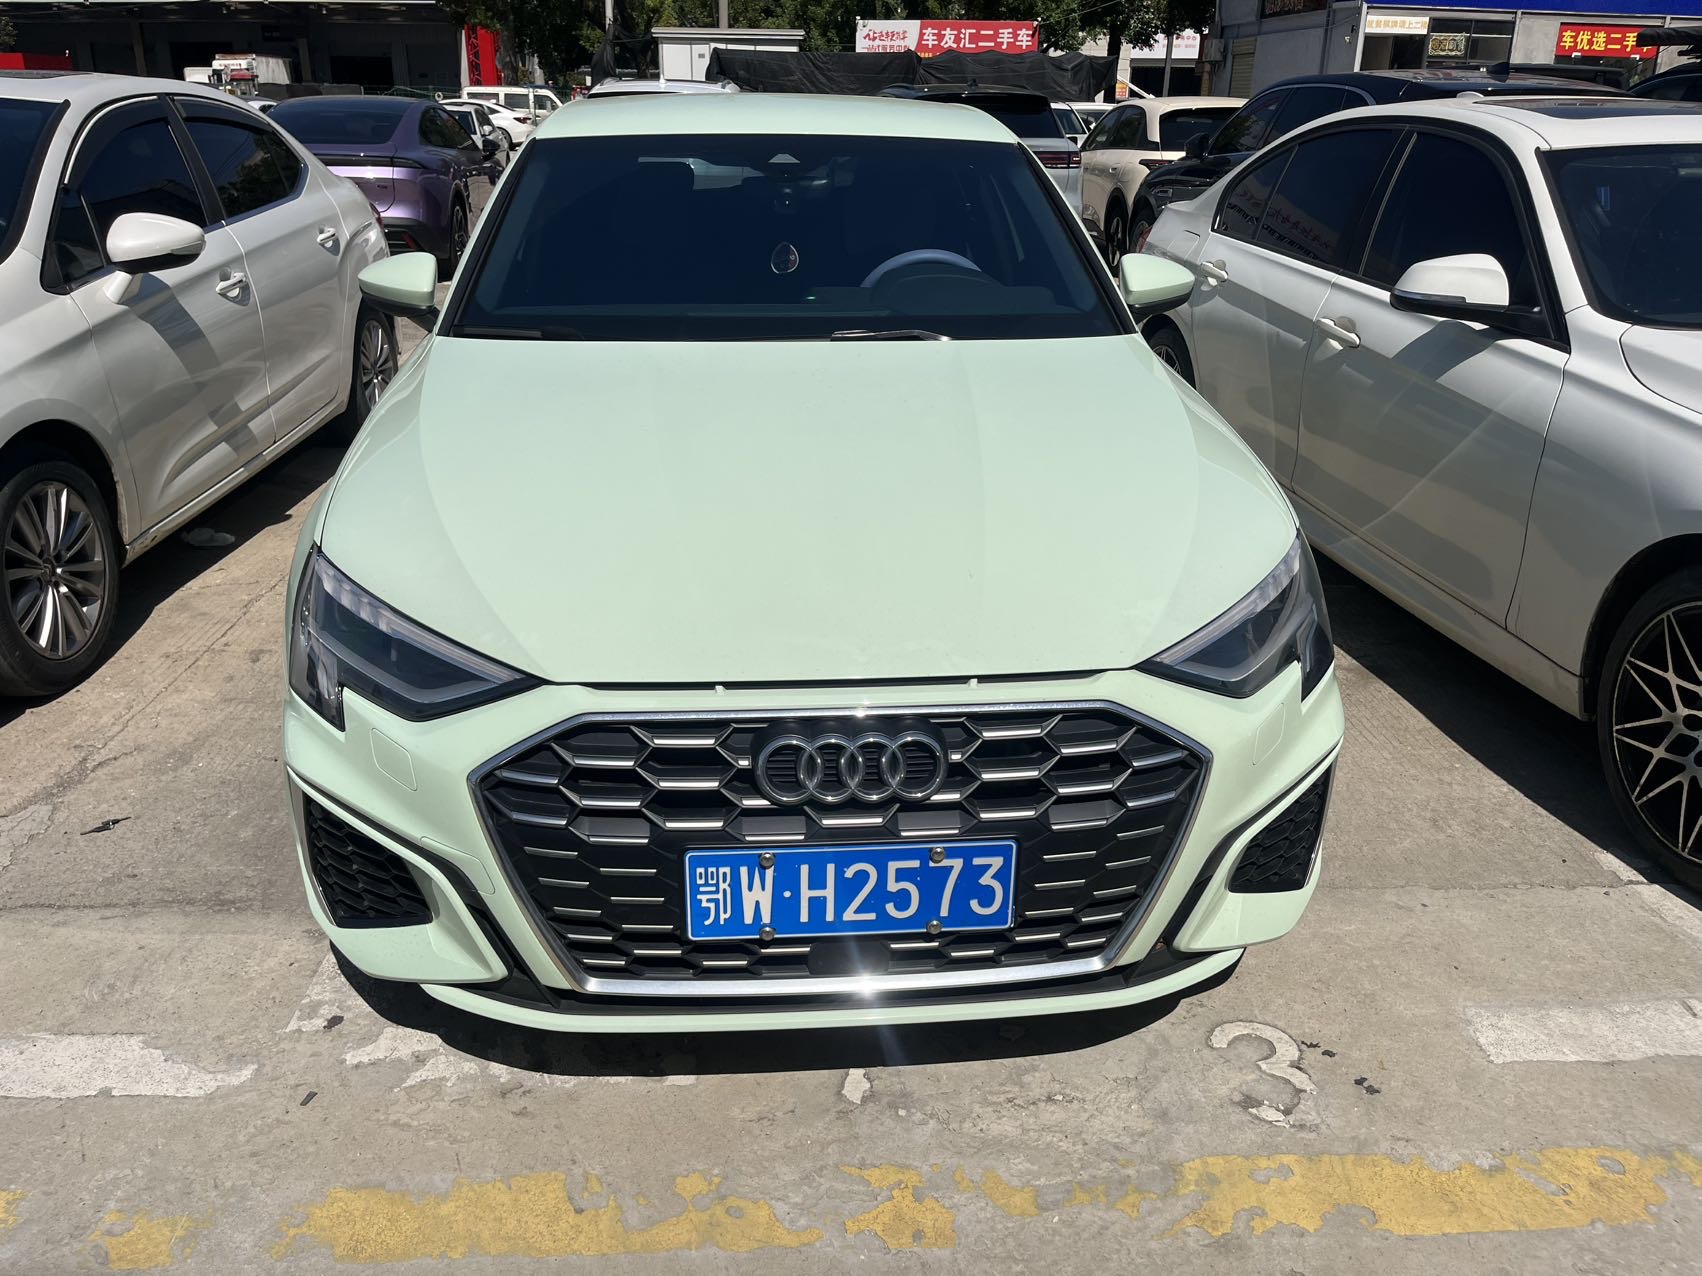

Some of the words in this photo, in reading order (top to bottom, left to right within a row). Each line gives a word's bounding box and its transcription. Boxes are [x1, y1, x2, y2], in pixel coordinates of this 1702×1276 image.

[921, 27, 1033, 49] 车友汇二手车
[696, 856, 1004, 925] 鄂W·H2573
[1208, 1021, 1319, 1128] 3
